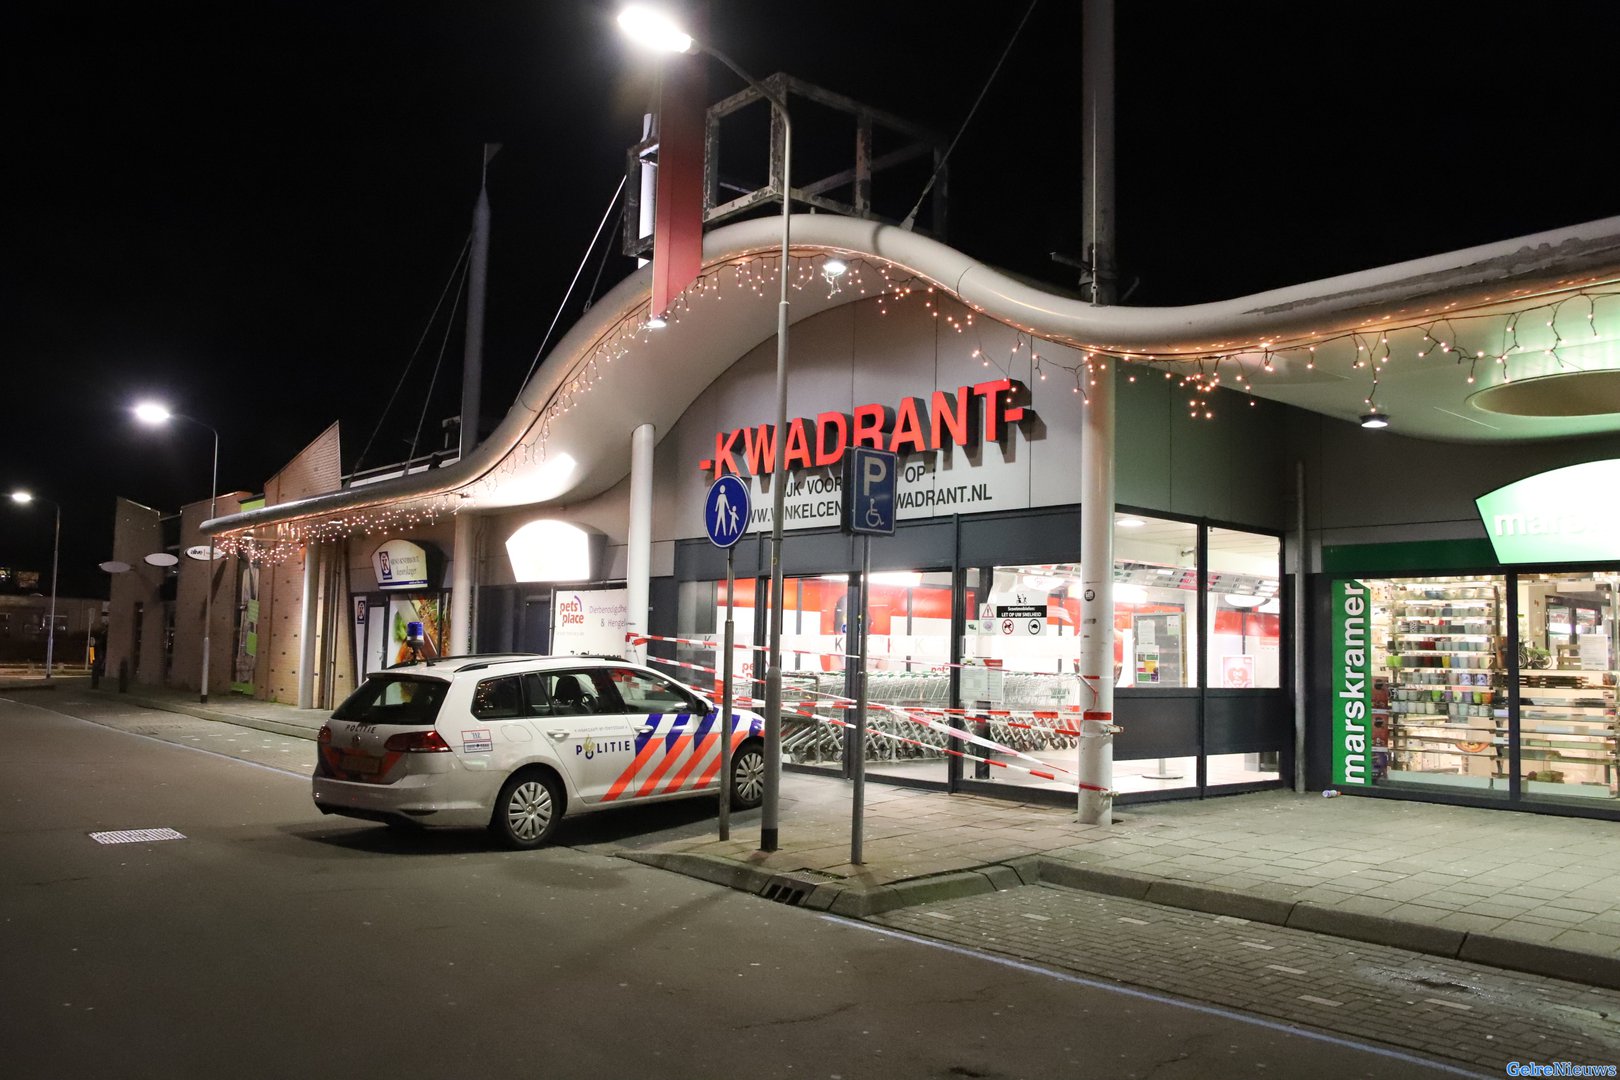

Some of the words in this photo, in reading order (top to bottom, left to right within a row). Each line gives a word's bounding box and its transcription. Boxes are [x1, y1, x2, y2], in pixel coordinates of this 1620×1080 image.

[863, 457, 886, 496] P
[905, 465, 926, 483] OP
[560, 601, 579, 616] pets
[561, 612, 584, 627] place
[1339, 583, 1365, 784] marskramer
[345, 724, 377, 734] POLITIE
[576, 740, 630, 760] POLITIE
